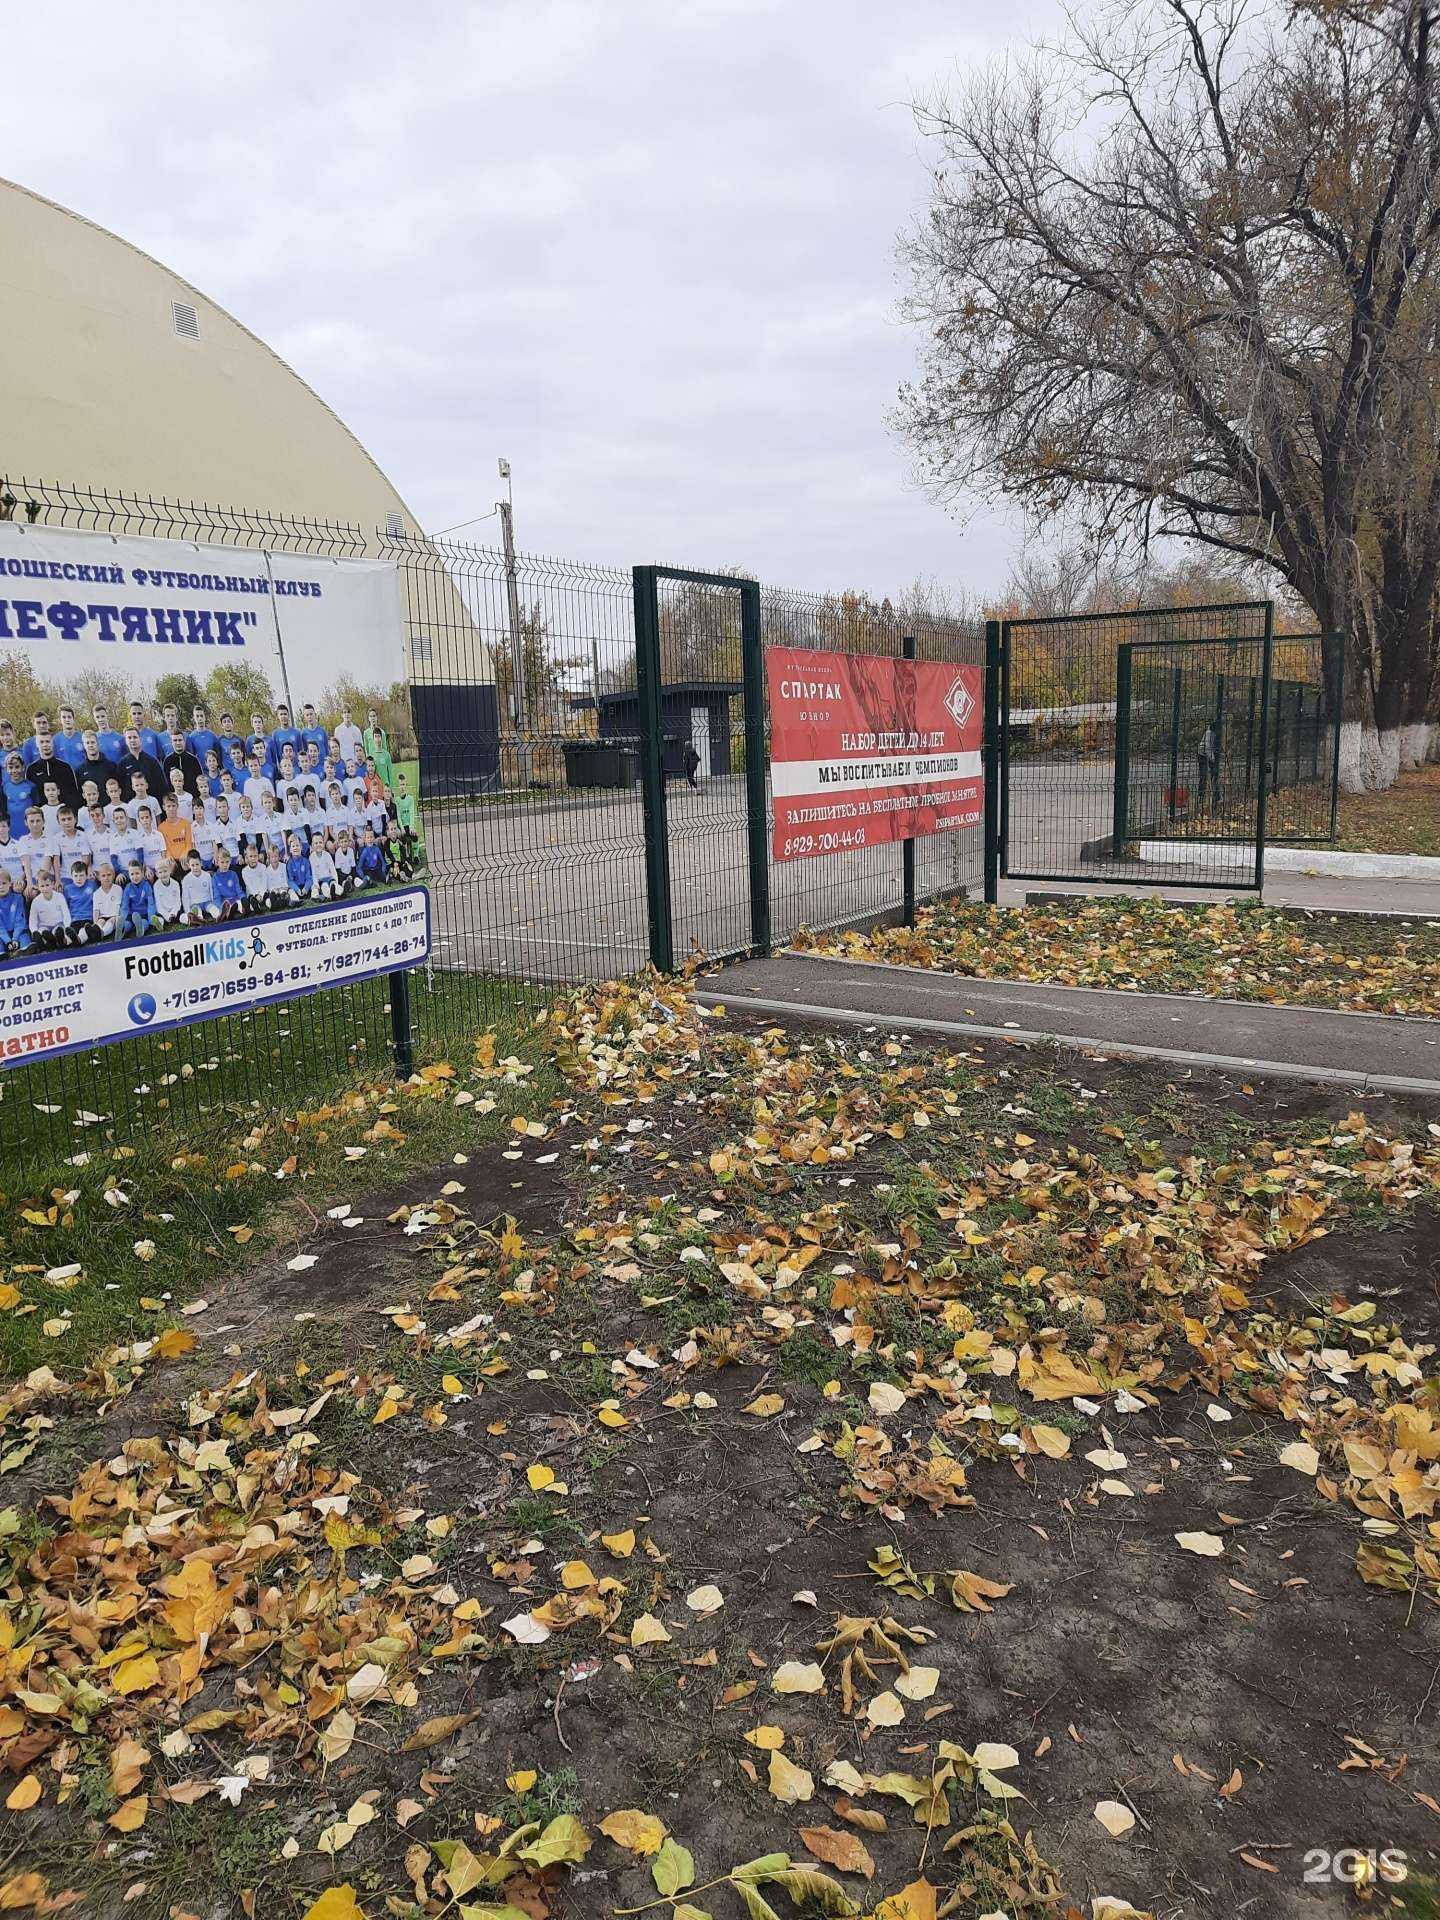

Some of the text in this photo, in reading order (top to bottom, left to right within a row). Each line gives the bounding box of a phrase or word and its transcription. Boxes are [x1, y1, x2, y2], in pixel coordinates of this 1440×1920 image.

[132, 568, 270, 594] ФУТБОЛЬНЫЙ
[274, 579, 322, 597] КЛУБ
[780, 680, 842, 700] СПАРТАК
[841, 733, 876, 751] НАБОР
[877, 729, 906, 752] ДЕТЕЙ
[929, 731, 945, 747] ЛЕТ
[818, 757, 958, 783] МЫ ВОСПИТЫВАЕМ ЧЕМПИОНОВ
[786, 803, 857, 825] ЗАПИШИТЕСЬ
[858, 802, 872, 816] НА
[873, 795, 919, 812] БЕСПЛАТНОЕ
[288, 899, 413, 935] ОТДЕЛЕНИЕ ДОШКОЛЬНОГО
[275, 934, 329, 954] ФУТБОЛА:
[331, 925, 373, 942] ГРУППЫ
[383, 919, 389, 930] 4
[390, 916, 402, 930] ДО
[403, 916, 409, 925] 7
[125, 937, 246, 979] FootballKids
[163, 935, 426, 1008] +7(927)659-84-81; +7(927)744-28-74
[38, 990, 53, 1003] 17
[0, 1001, 82, 1027] ОВОДЯТСЯ
